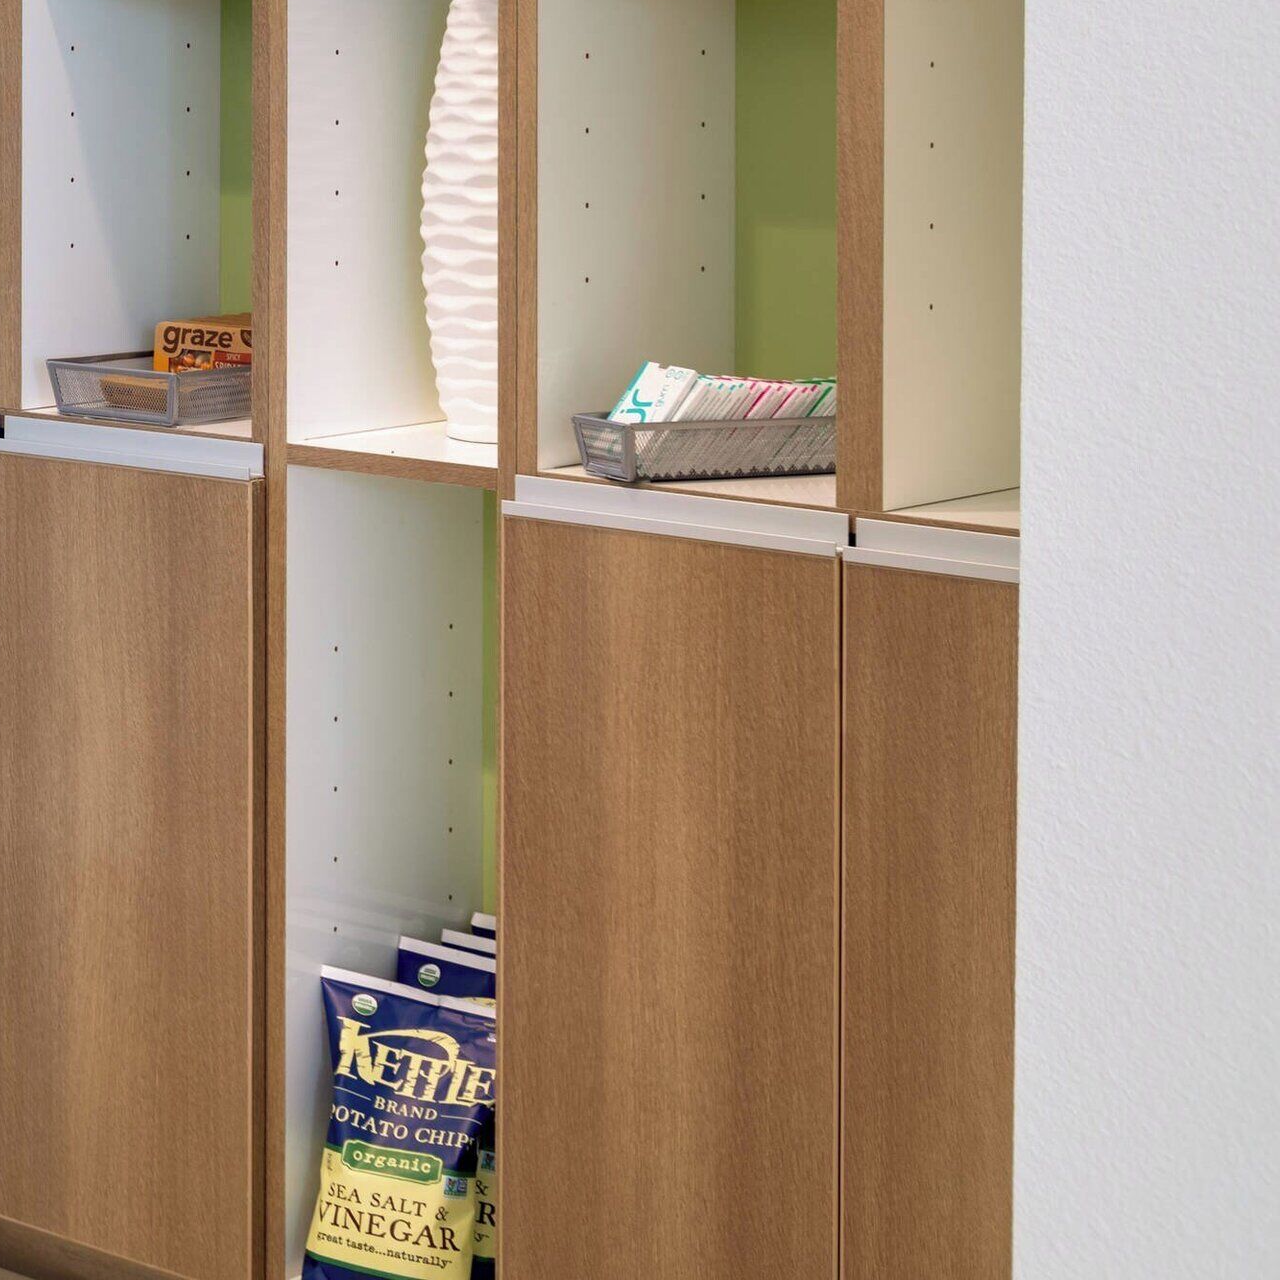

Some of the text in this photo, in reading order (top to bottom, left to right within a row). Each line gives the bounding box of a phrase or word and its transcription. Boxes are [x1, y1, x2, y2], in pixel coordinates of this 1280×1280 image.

[162, 325, 233, 354] graze
[334, 1016, 496, 1106] KETTLE
[374, 1095, 438, 1121] BRAND
[353, 1149, 432, 1174] organic
[328, 1182, 449, 1221] SEA SALT &
[317, 1231, 343, 1246] great
[318, 1199, 460, 1252] VINEGAR
